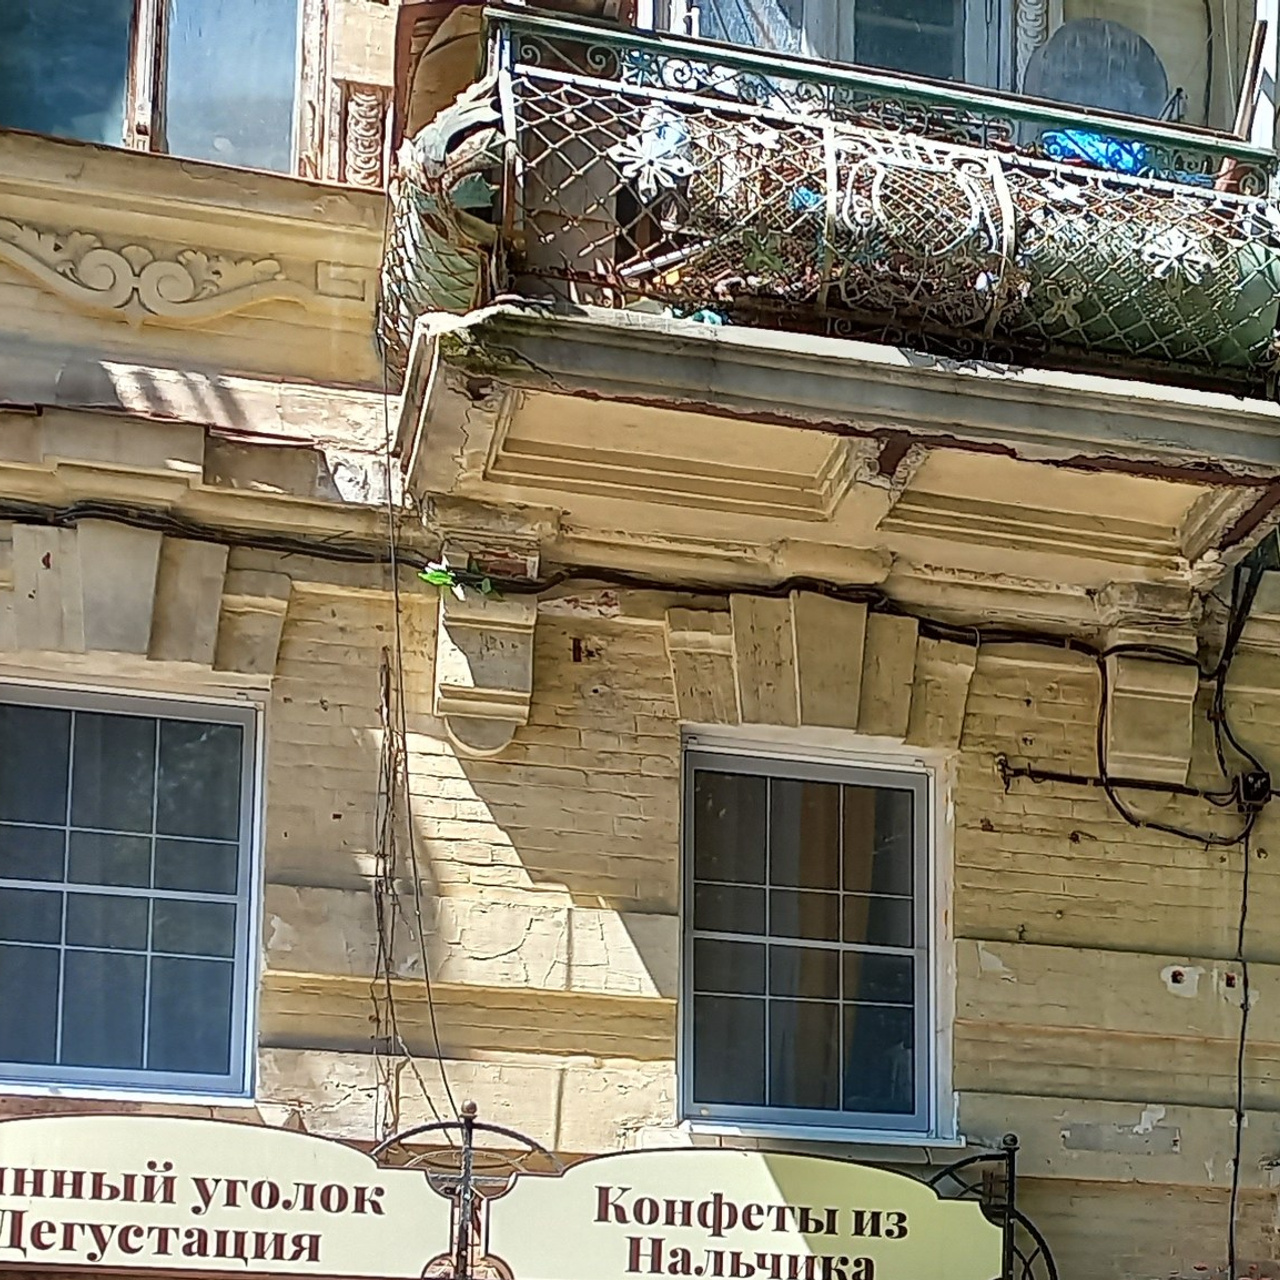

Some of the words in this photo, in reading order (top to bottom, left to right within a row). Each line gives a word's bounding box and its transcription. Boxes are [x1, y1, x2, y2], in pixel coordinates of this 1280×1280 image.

[0, 1160, 178, 1205] нный
[191, 1176, 386, 1216] уголок
[593, 1185, 840, 1237] Конфеты
[852, 1208, 909, 1240] из
[0, 1208, 321, 1263] Дегустация
